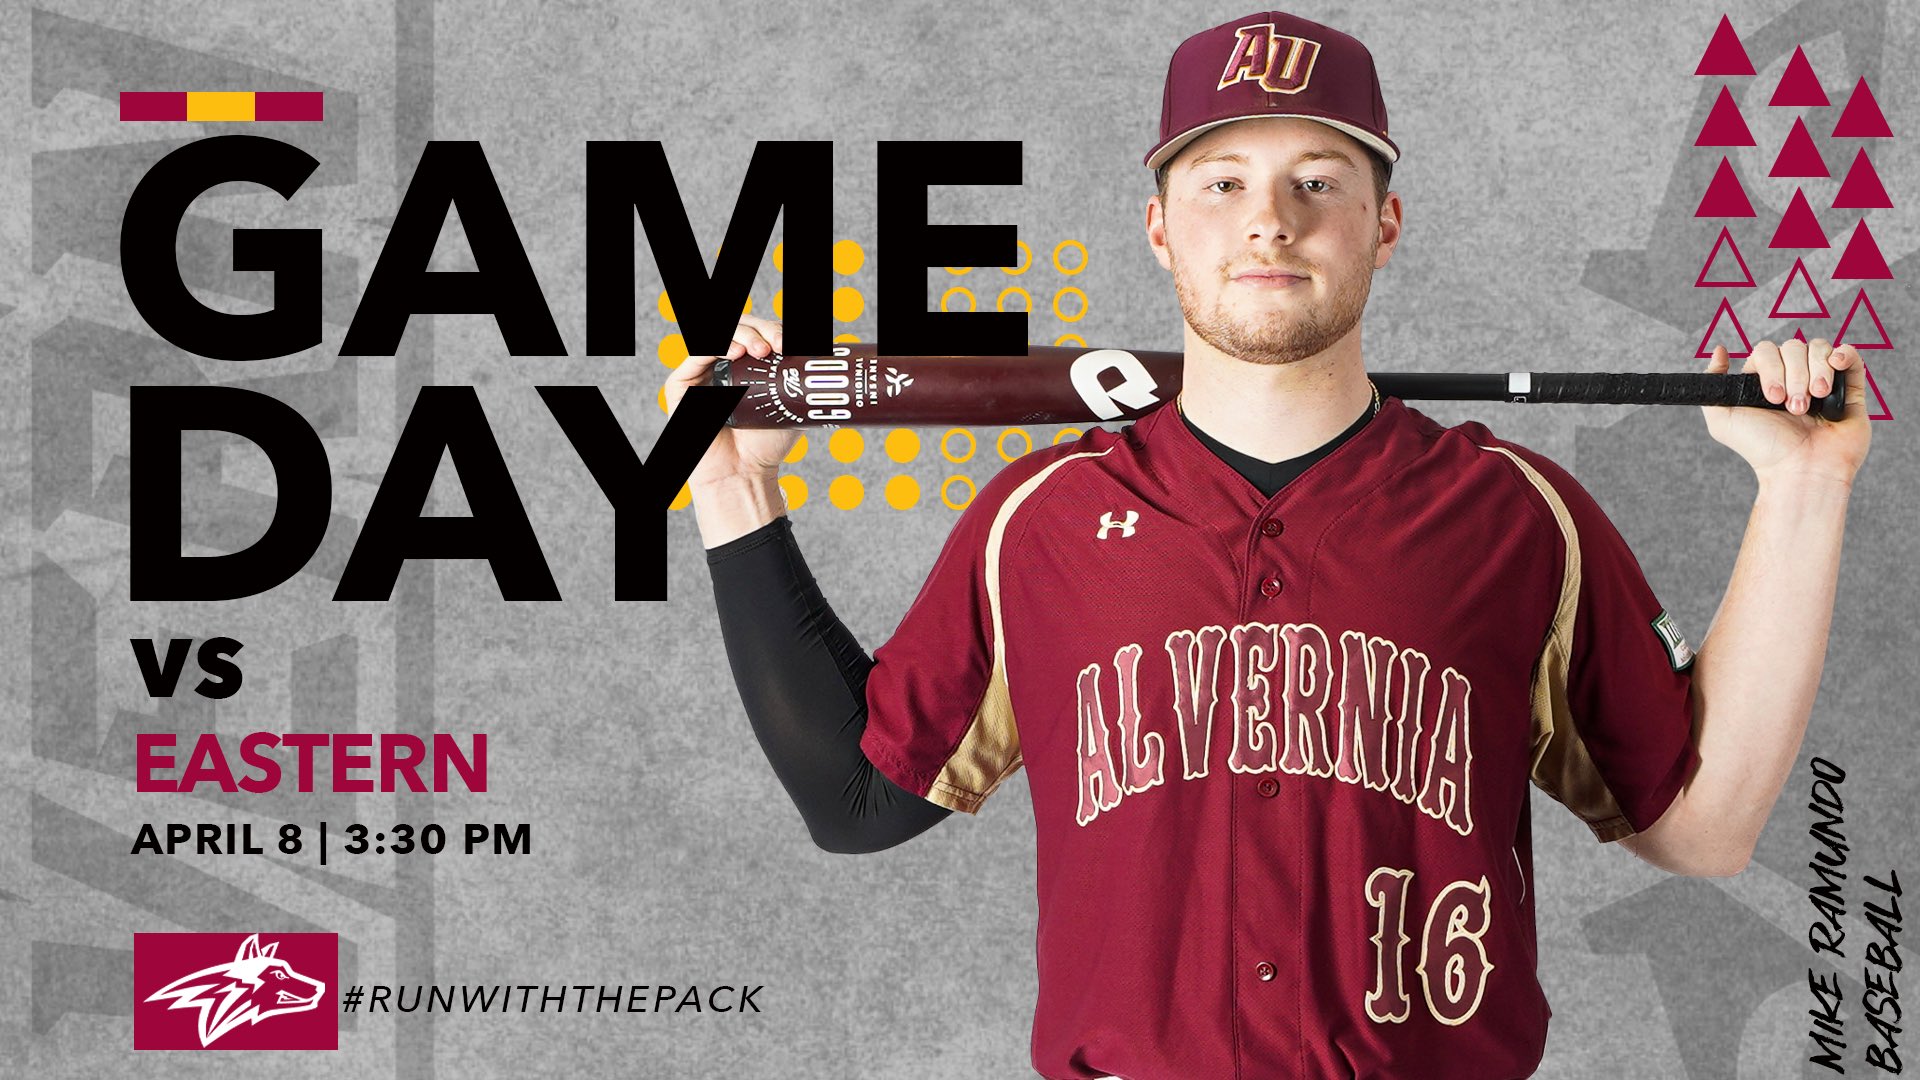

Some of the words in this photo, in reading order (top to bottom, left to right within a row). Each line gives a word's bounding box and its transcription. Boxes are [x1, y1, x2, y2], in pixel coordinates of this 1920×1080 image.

[1217, 23, 1321, 94] AU
[781, 367, 804, 398] The
[854, 357, 865, 408] ORIGINAL
[1076, 622, 1473, 836] ALVERNIA
[1364, 866, 1494, 1026] 16
